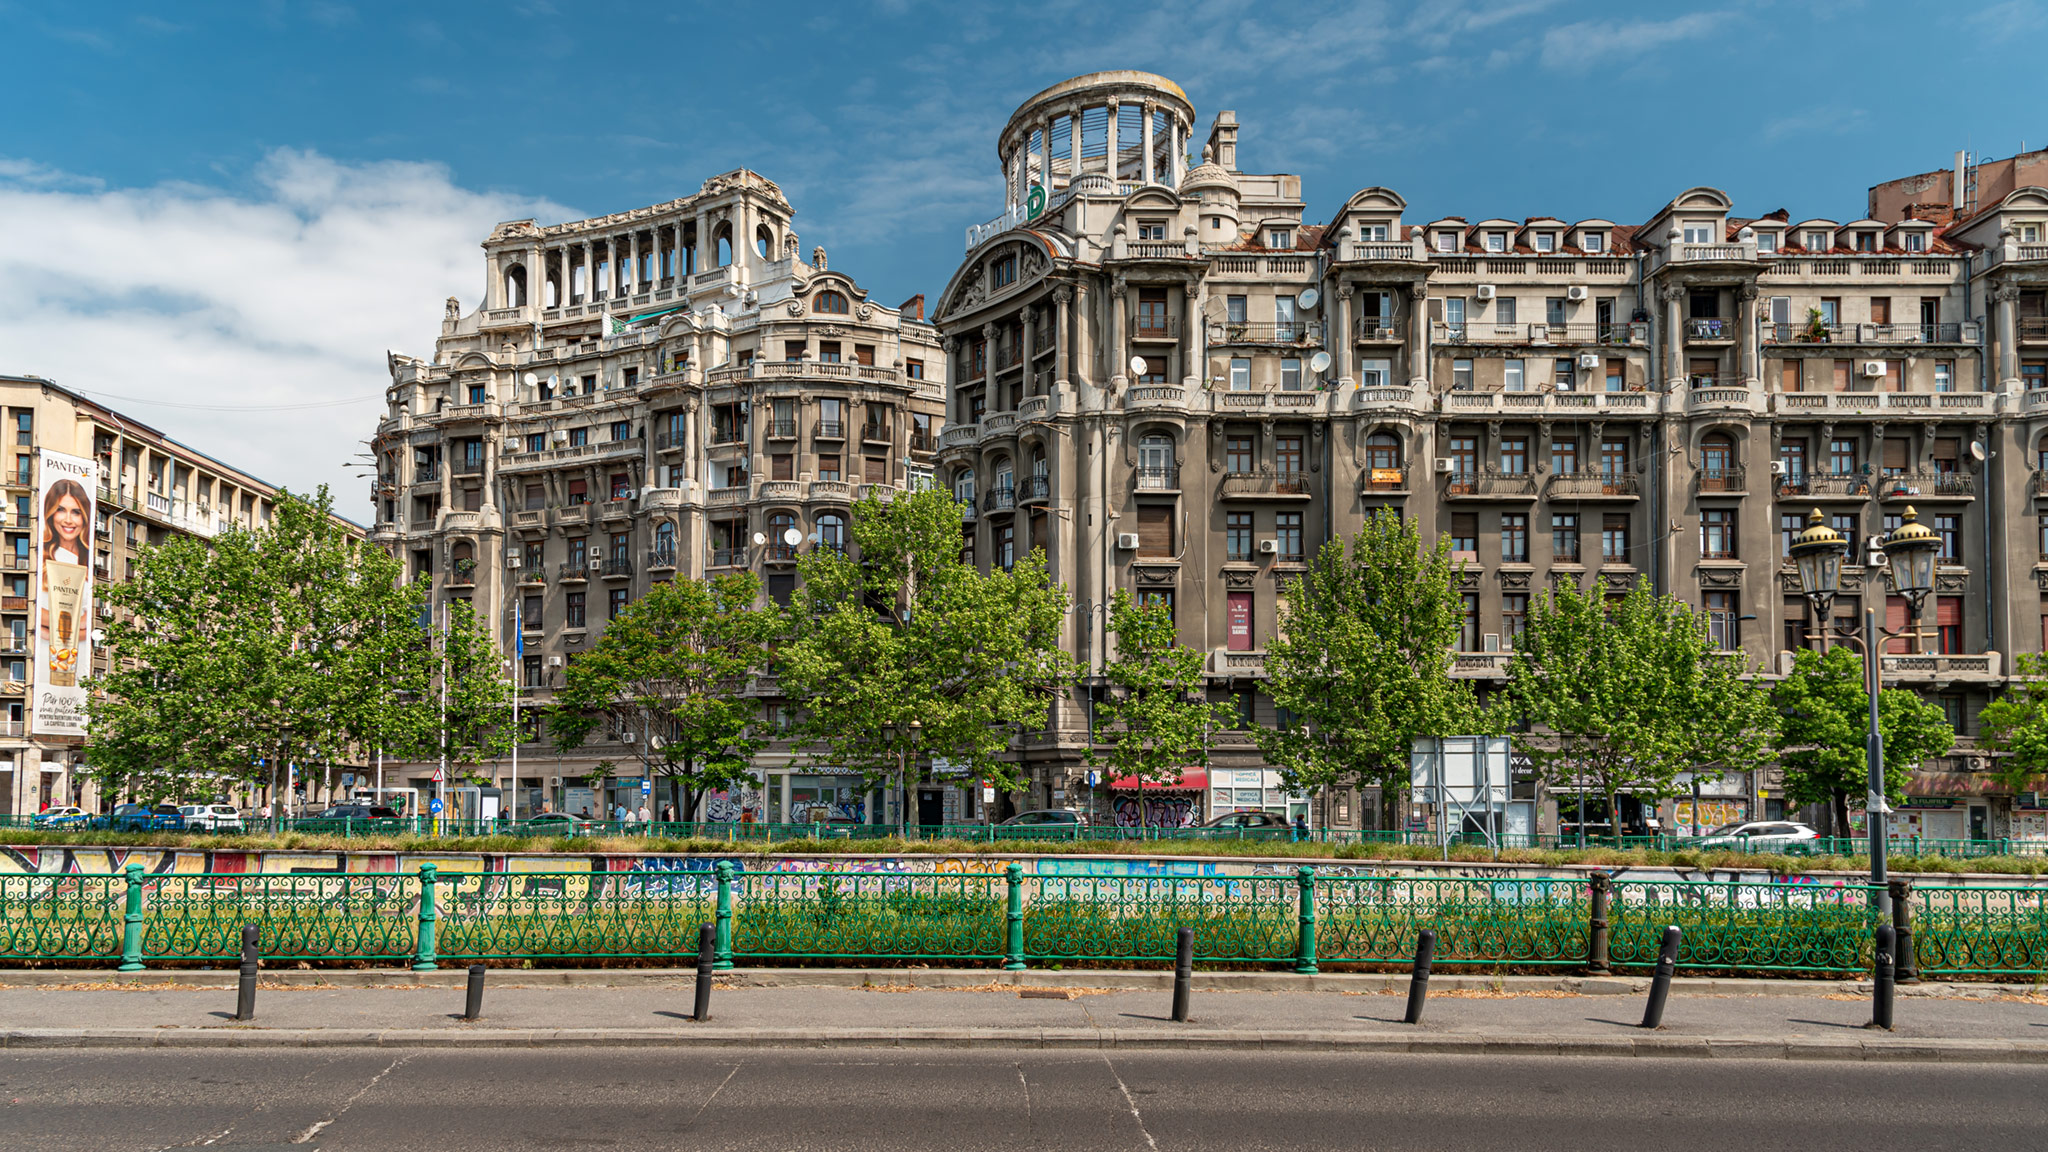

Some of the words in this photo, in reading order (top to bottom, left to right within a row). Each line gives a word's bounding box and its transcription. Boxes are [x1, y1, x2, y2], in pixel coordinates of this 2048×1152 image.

[46, 458, 91, 477] PANTENE
[53, 586, 79, 595] PANTENE
[58, 696, 79, 706] 100%
